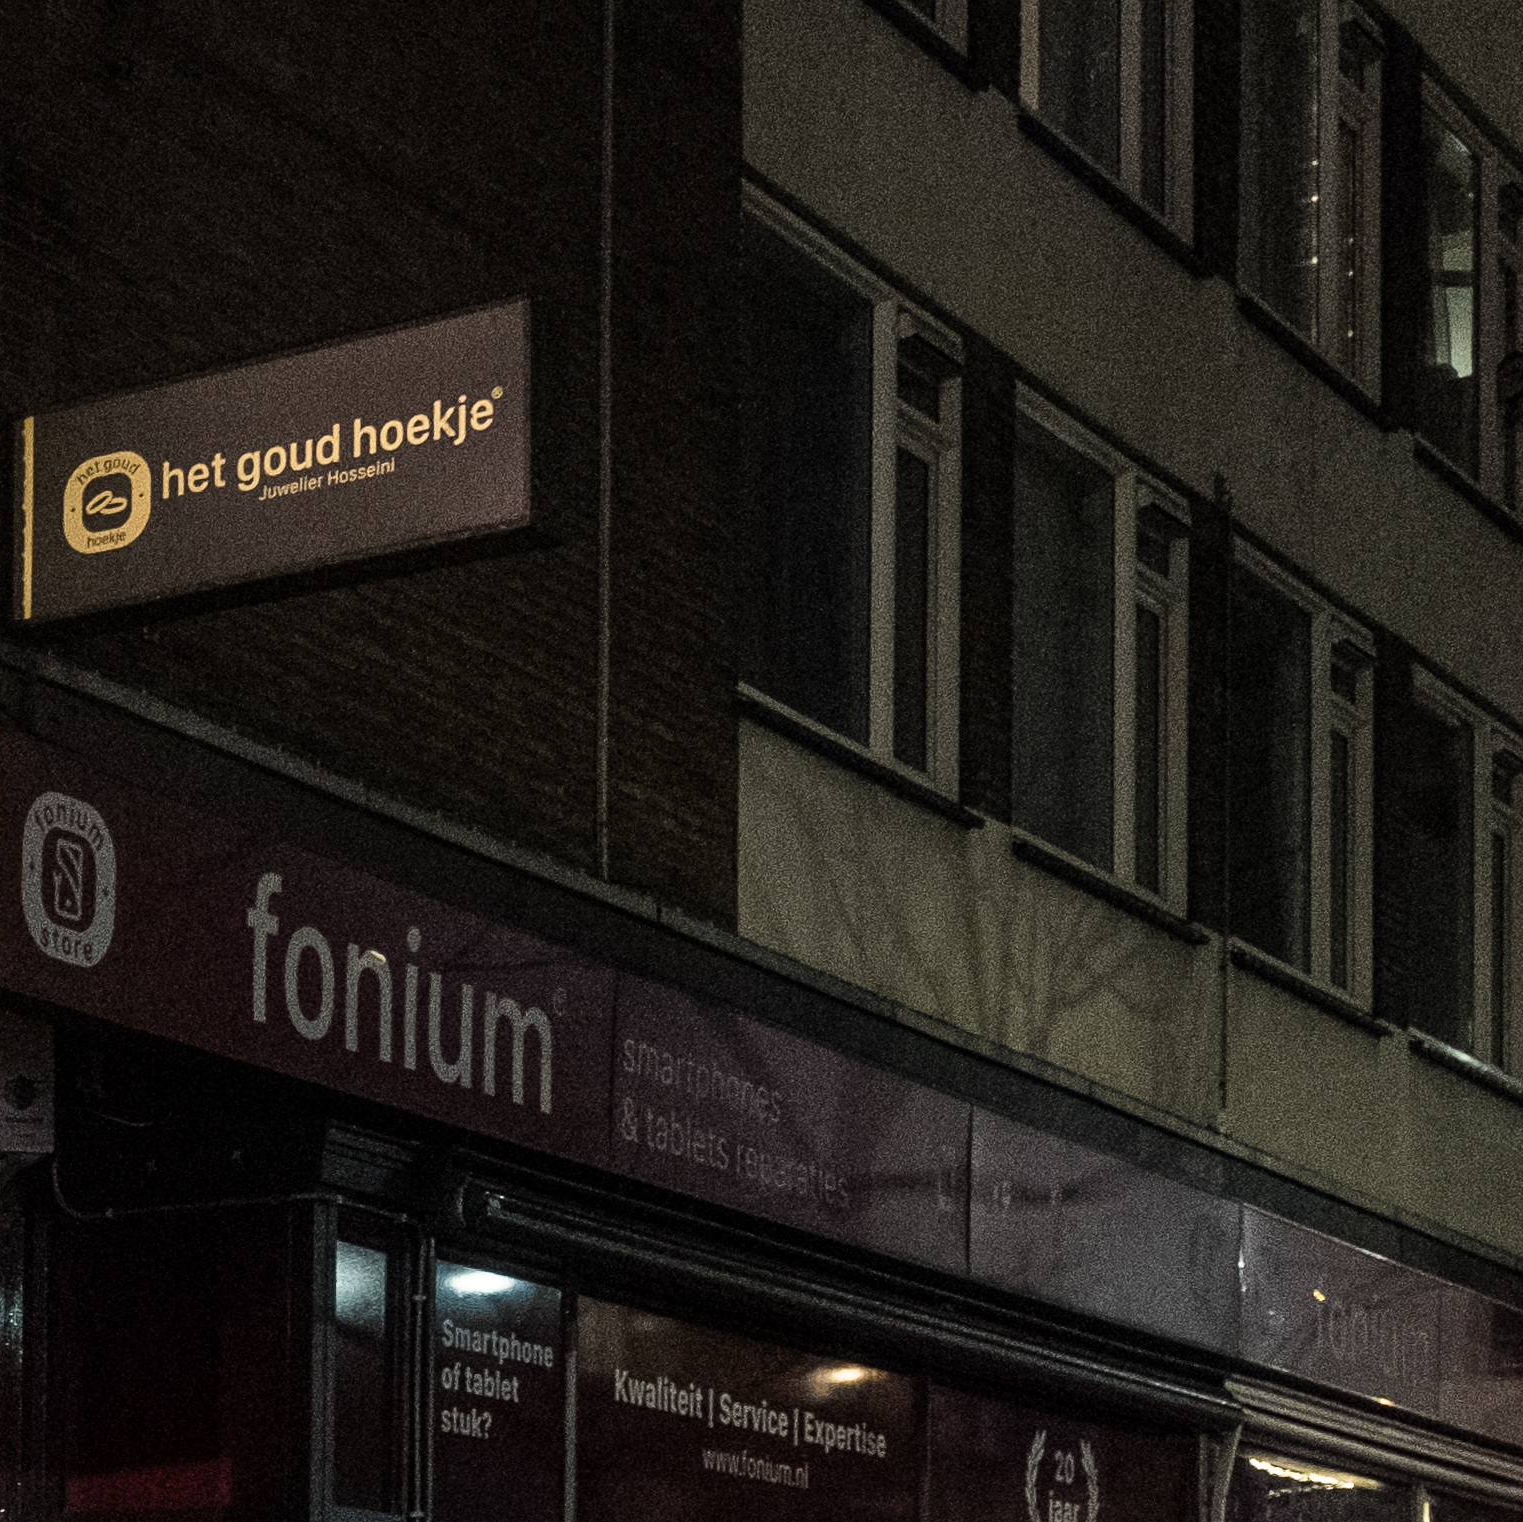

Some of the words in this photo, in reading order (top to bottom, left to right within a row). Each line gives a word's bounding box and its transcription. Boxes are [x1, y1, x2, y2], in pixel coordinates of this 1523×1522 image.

[76, 460, 100, 485] het
[103, 458, 141, 476] goud
[162, 452, 226, 500] het
[237, 423, 341, 492] goud
[259, 476, 323, 501] Juwelier
[327, 457, 396, 487] Hosseini
[34, 802, 105, 852] fonium
[40, 928, 94, 963] store
[248, 872, 553, 1115] fonium
[623, 1038, 783, 1123] smartphones
[622, 1097, 639, 1143] &
[647, 1106, 729, 1171] tablets
[442, 1319, 554, 1368] Smartphone
[442, 1362, 461, 1390] of
[465, 1366, 519, 1403] tablet
[442, 1407, 492, 1439] stuk?
[615, 1368, 703, 1420] Kwaliteit
[719, 1392, 790, 1438] Service
[804, 1411, 887, 1458] Expertise
[702, 1448, 810, 1489] www.fonium.nl
[1054, 1449, 1076, 1485] 20
